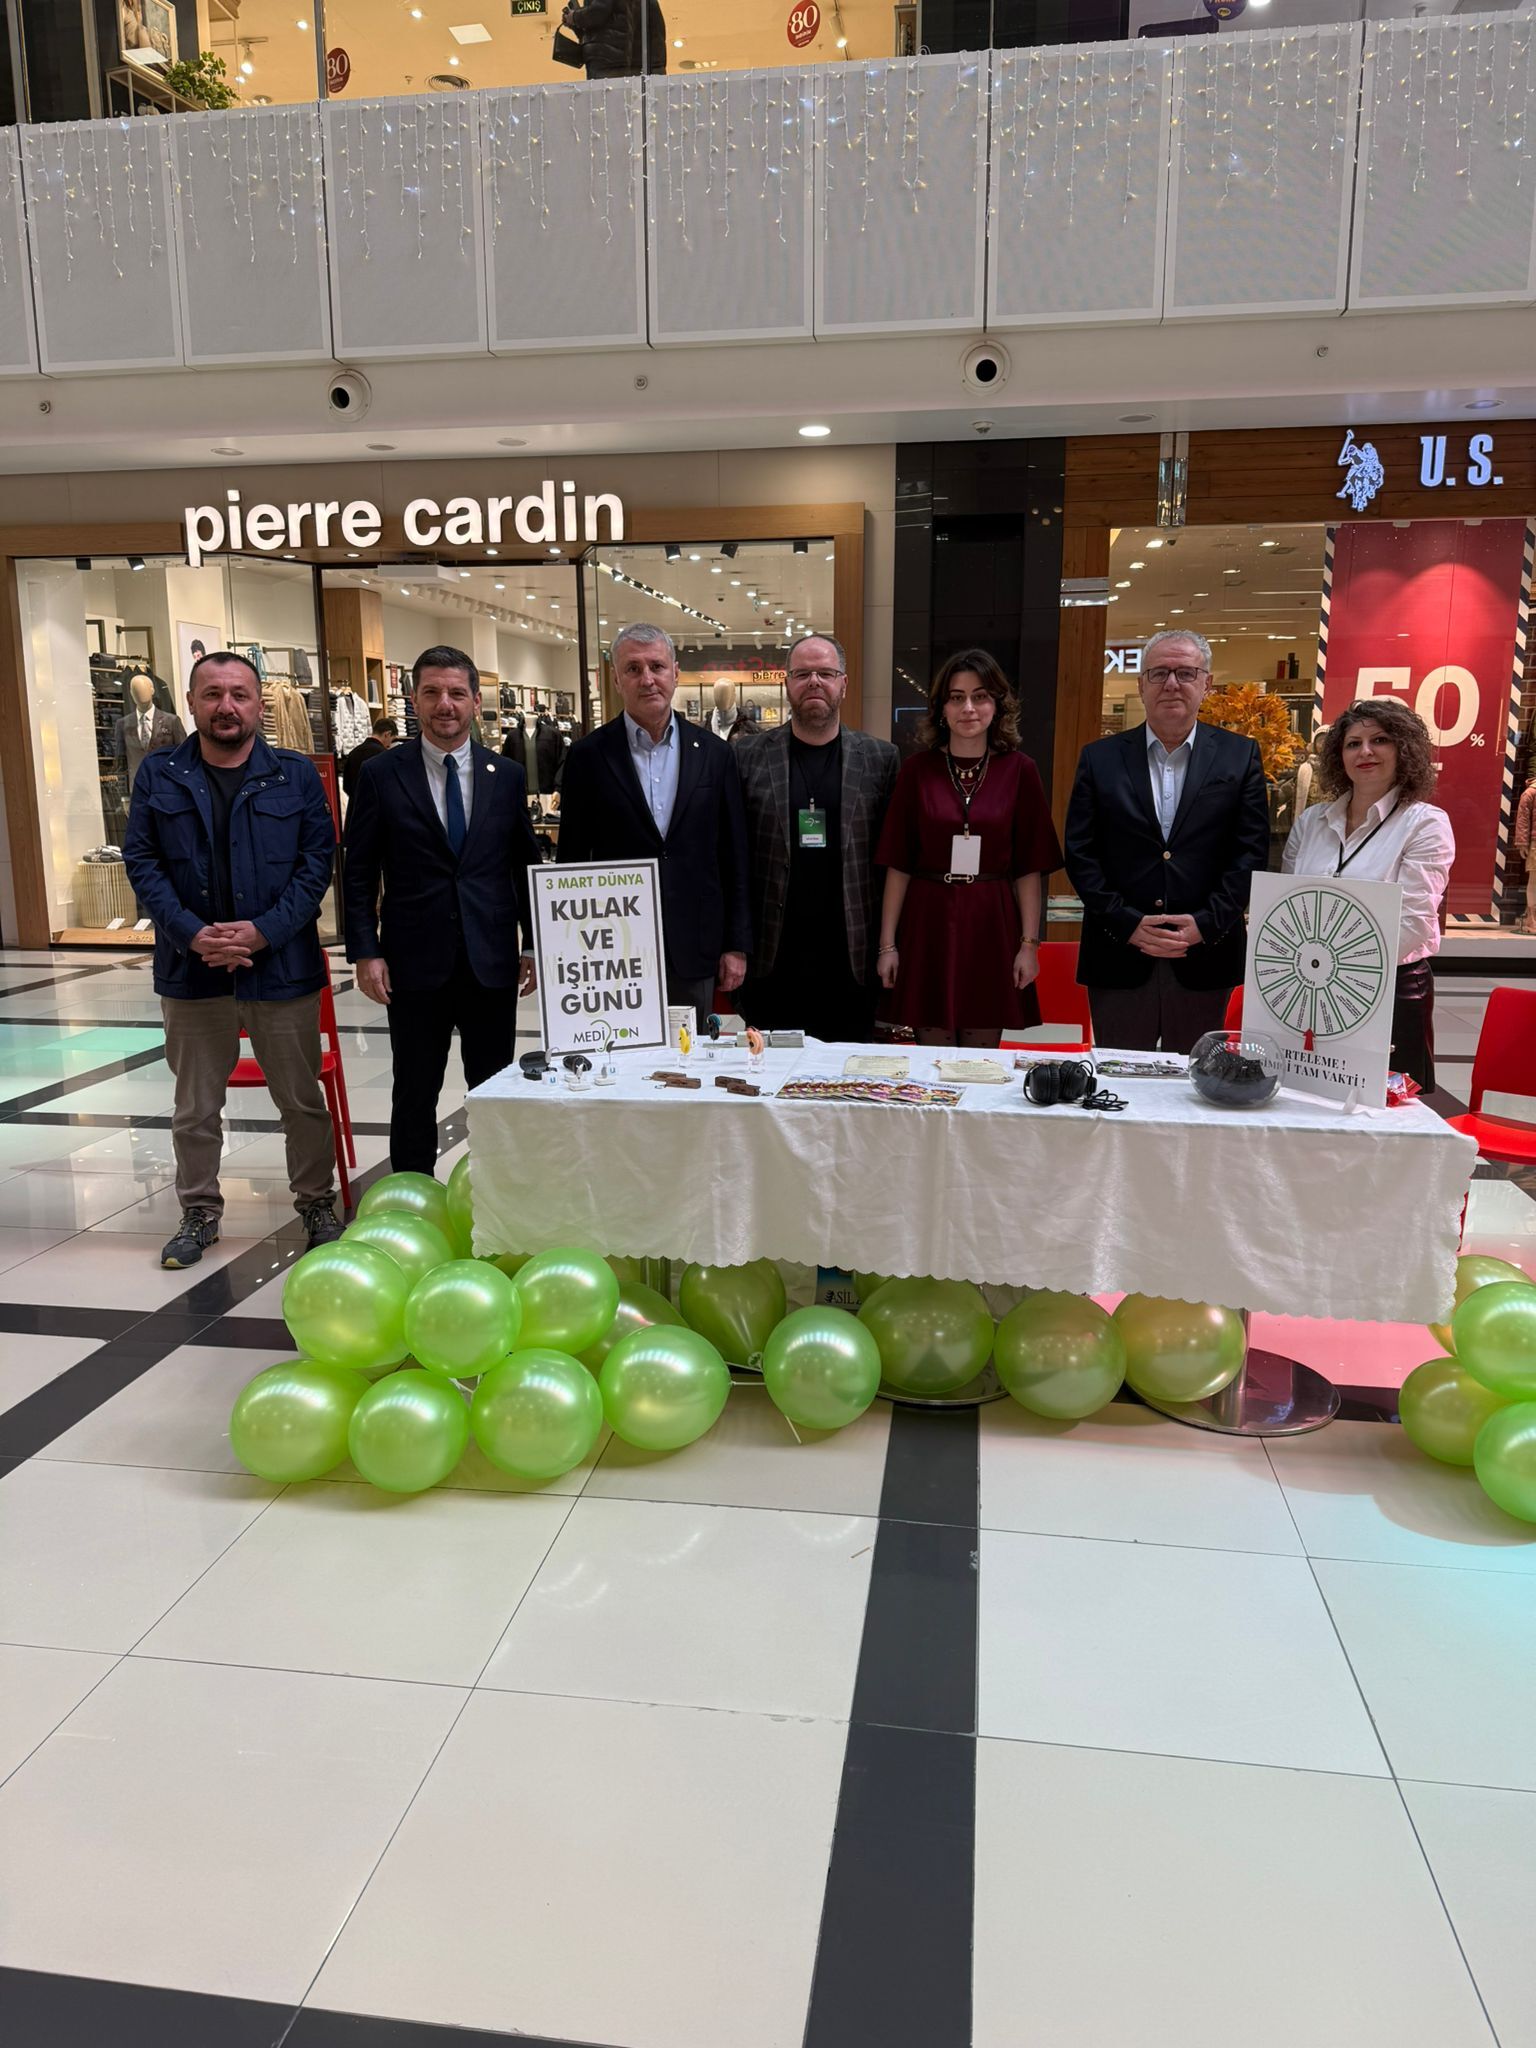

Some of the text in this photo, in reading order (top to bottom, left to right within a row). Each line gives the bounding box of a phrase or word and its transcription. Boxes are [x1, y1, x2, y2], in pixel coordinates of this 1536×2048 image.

[184, 480, 625, 568] pierre cardin
[546, 872, 644, 890] 3 MART DÜNYA
[551, 896, 641, 922] KULAK
[580, 928, 614, 951] VE
[557, 955, 643, 989] İŞİTME
[561, 982, 643, 1015] GÜNÜ
[1294, 1064, 1319, 1079] TAM
[1322, 1070, 1358, 1087] VAKTİ
